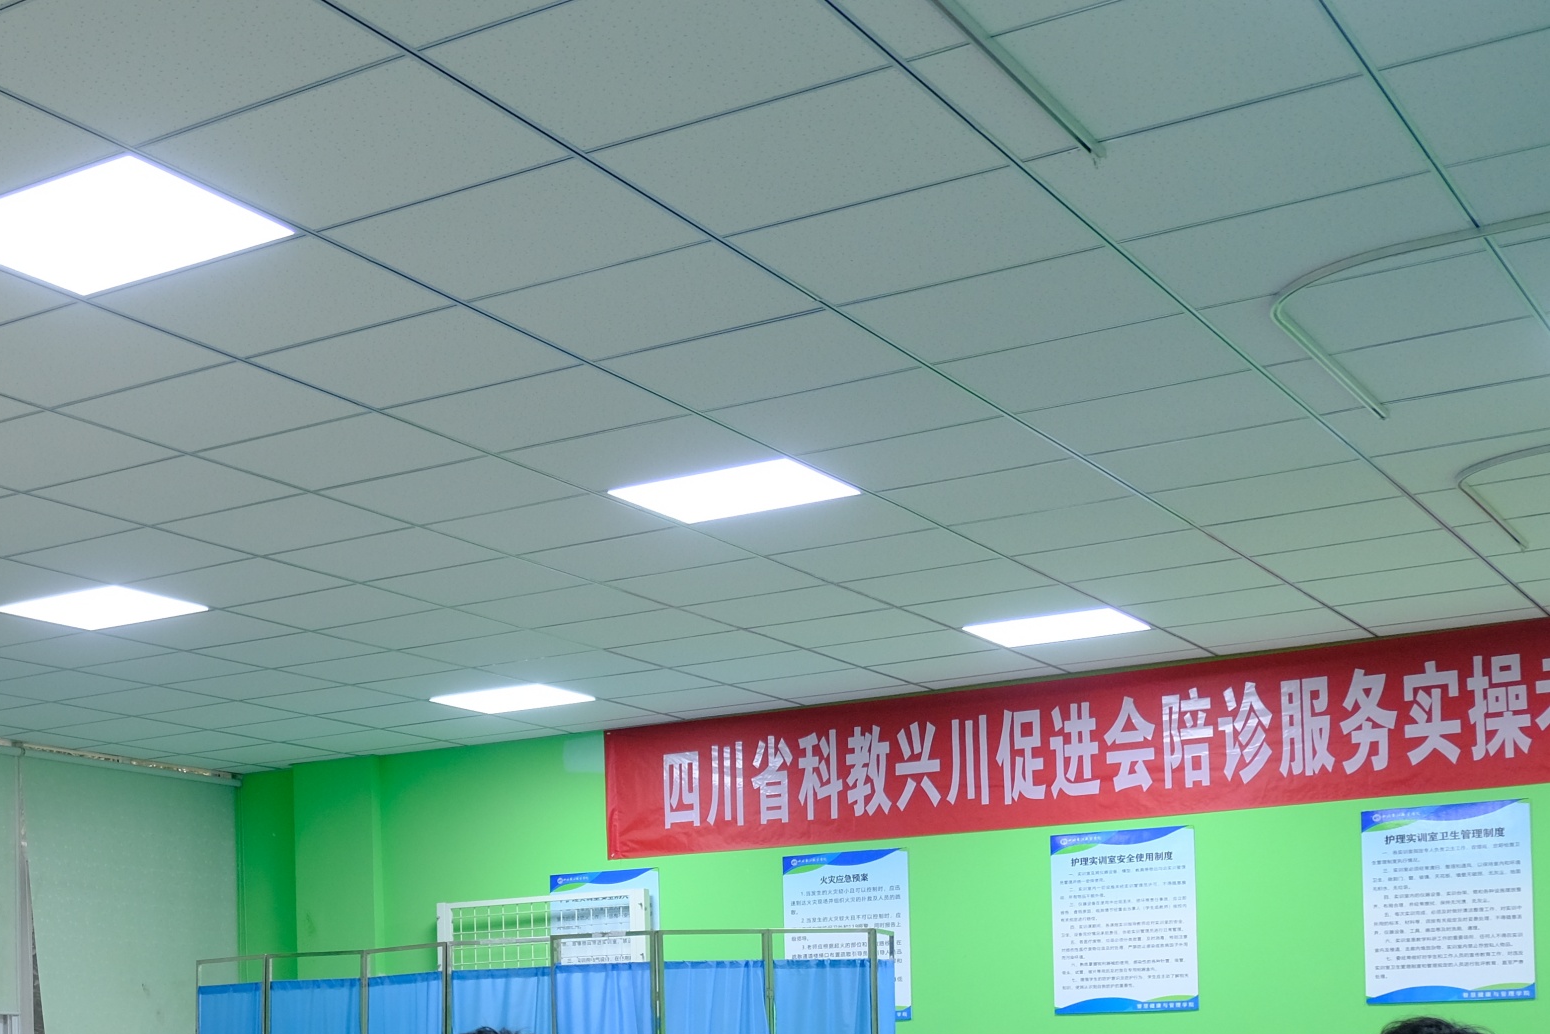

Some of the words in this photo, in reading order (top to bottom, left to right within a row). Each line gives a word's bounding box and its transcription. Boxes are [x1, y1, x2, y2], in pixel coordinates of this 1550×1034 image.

[1384, 827, 1505, 845] 护理实训室卫生管理制度
[1071, 851, 1173, 867] 护理实训室安全使用制度
[820, 873, 869, 885] 火灾应急预案
